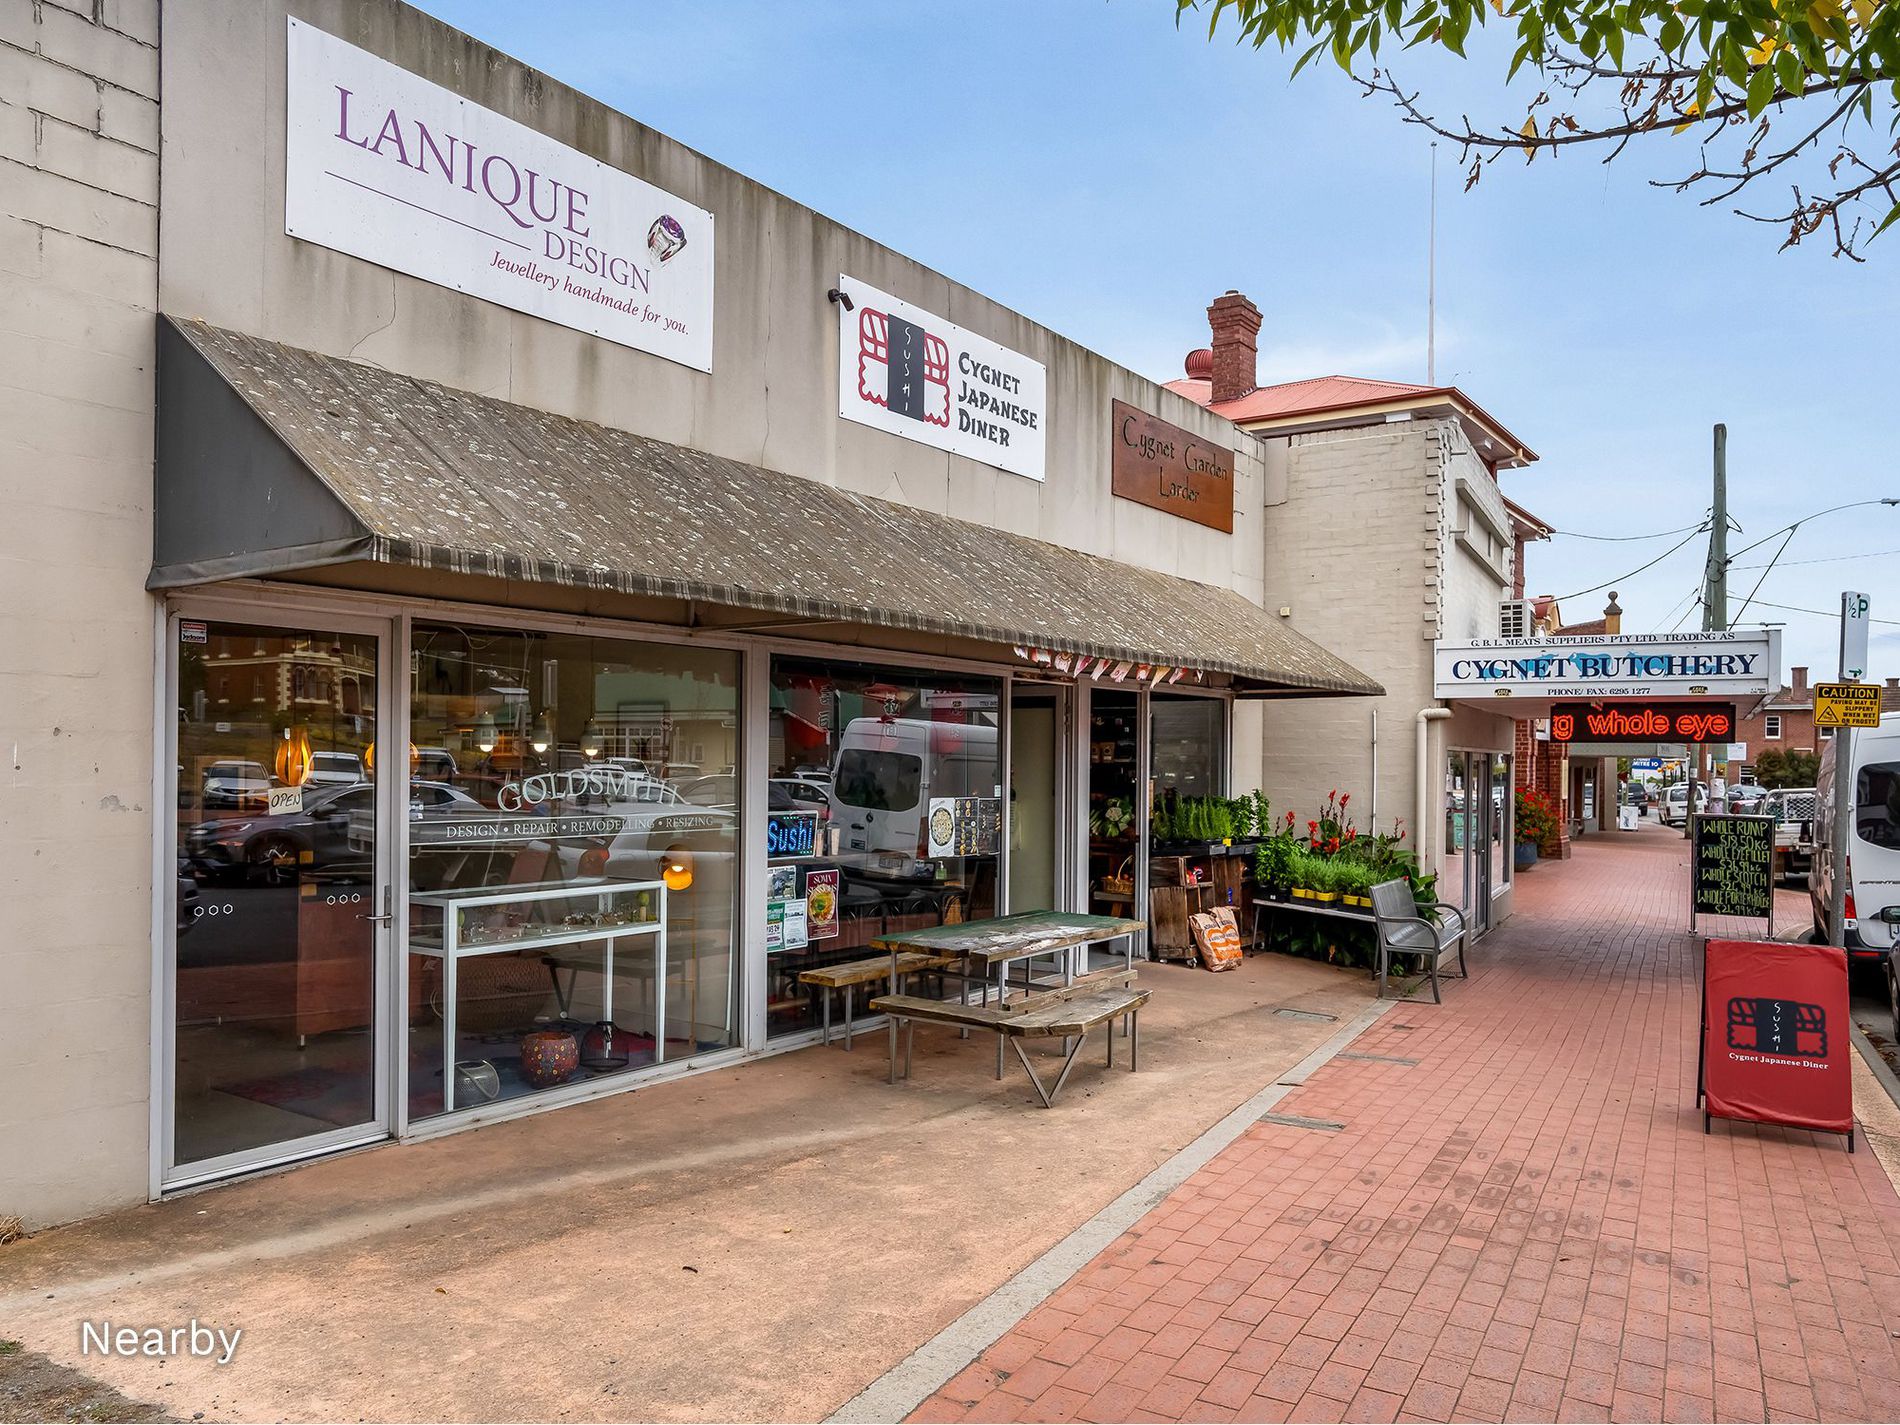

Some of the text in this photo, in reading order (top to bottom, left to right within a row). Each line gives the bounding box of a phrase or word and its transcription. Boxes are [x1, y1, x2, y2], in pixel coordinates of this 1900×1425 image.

[334, 84, 590, 237] LANIQUE
[543, 229, 651, 294] DESIGN
[490, 251, 689, 335] Jewellery handmade for you.
[902, 326, 911, 411] SUSHI
[958, 351, 1021, 394] CYGNET
[958, 380, 1038, 430] JAPANESE
[958, 407, 1010, 447] DINER
[1123, 415, 1228, 480] Cygnet Garden
[1159, 466, 1200, 503] Larder
[1505, 637, 1541, 646] MEATS
[1545, 635, 1605, 645] SUPPLIERS
[1610, 635, 1633, 643] PTY
[1664, 633, 1716, 641] TRADING
[1720, 632, 1735, 640] AS
[1453, 653, 1760, 680] CYGNET BUTCHERY
[1609, 687, 1629, 695] 6295
[1632, 687, 1651, 695] 1277
[1821, 687, 1875, 698] CAUTION
[1553, 710, 1729, 741] g whole eye
[271, 793, 301, 807] OPEN
[497, 769, 680, 812] GOLDSMITH
[446, 815, 714, 838] DESIGN REPAIR REMODELLING RESIZING
[767, 819, 813, 853] Sushi
[1702, 820, 1768, 837] WHOLE RUMP
[1702, 846, 1731, 860] WHOLE
[1702, 868, 1767, 887] WHOLE SCOTCH
[1772, 1001, 1781, 1052] SUSHI
[1729, 1052, 1829, 1070] Cygnet Japanese Diner
